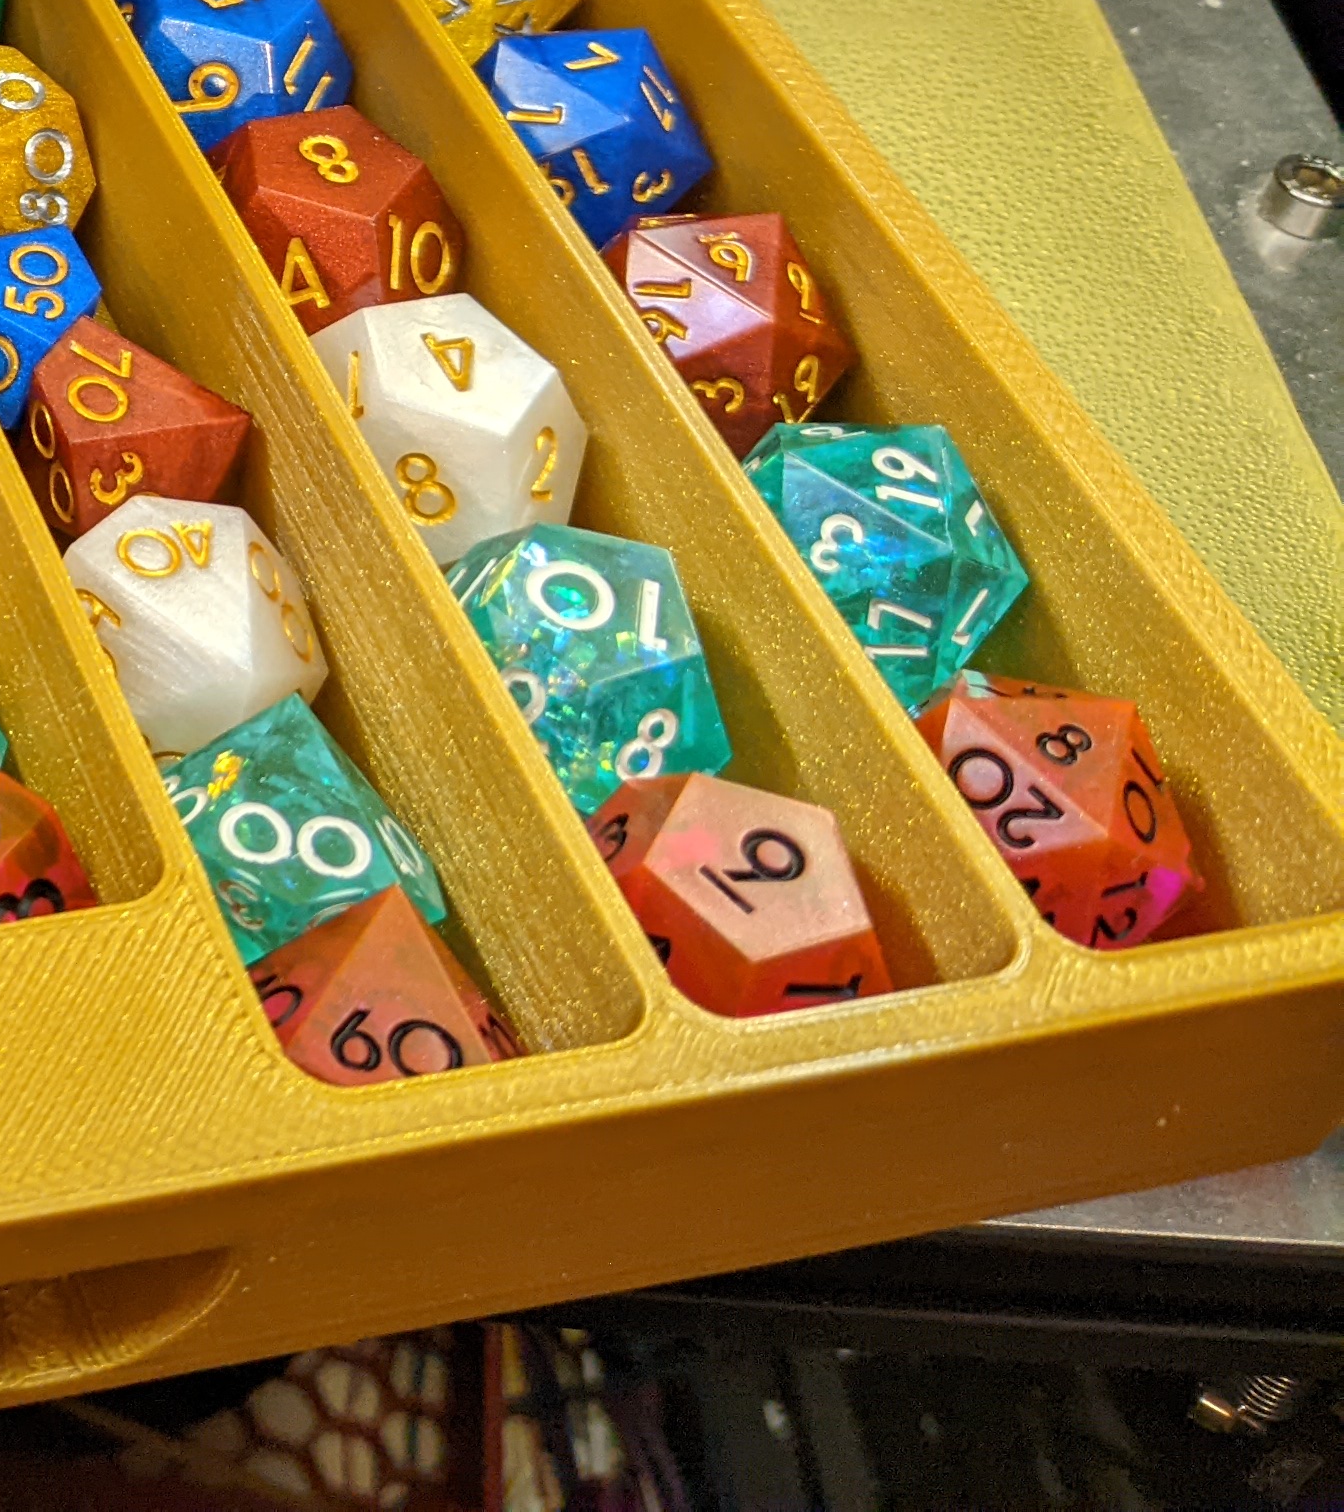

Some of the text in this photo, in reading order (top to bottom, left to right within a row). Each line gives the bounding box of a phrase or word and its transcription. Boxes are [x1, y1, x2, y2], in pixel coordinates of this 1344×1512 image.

[299, 134, 359, 184] 8
[633, 170, 672, 203] 3
[4, 242, 69, 320] 50
[280, 237, 330, 309] 4
[388, 213, 451, 295] 10
[68, 340, 133, 423] 70
[421, 332, 475, 392] 4
[395, 452, 456, 526] 8
[531, 426, 558, 503] 2
[810, 514, 863, 573] 3
[616, 708, 679, 781] 8
[1036, 723, 1092, 766] 8
[947, 747, 1064, 849] 20
[218, 801, 372, 879] 00
[330, 1009, 464, 1078] 60
